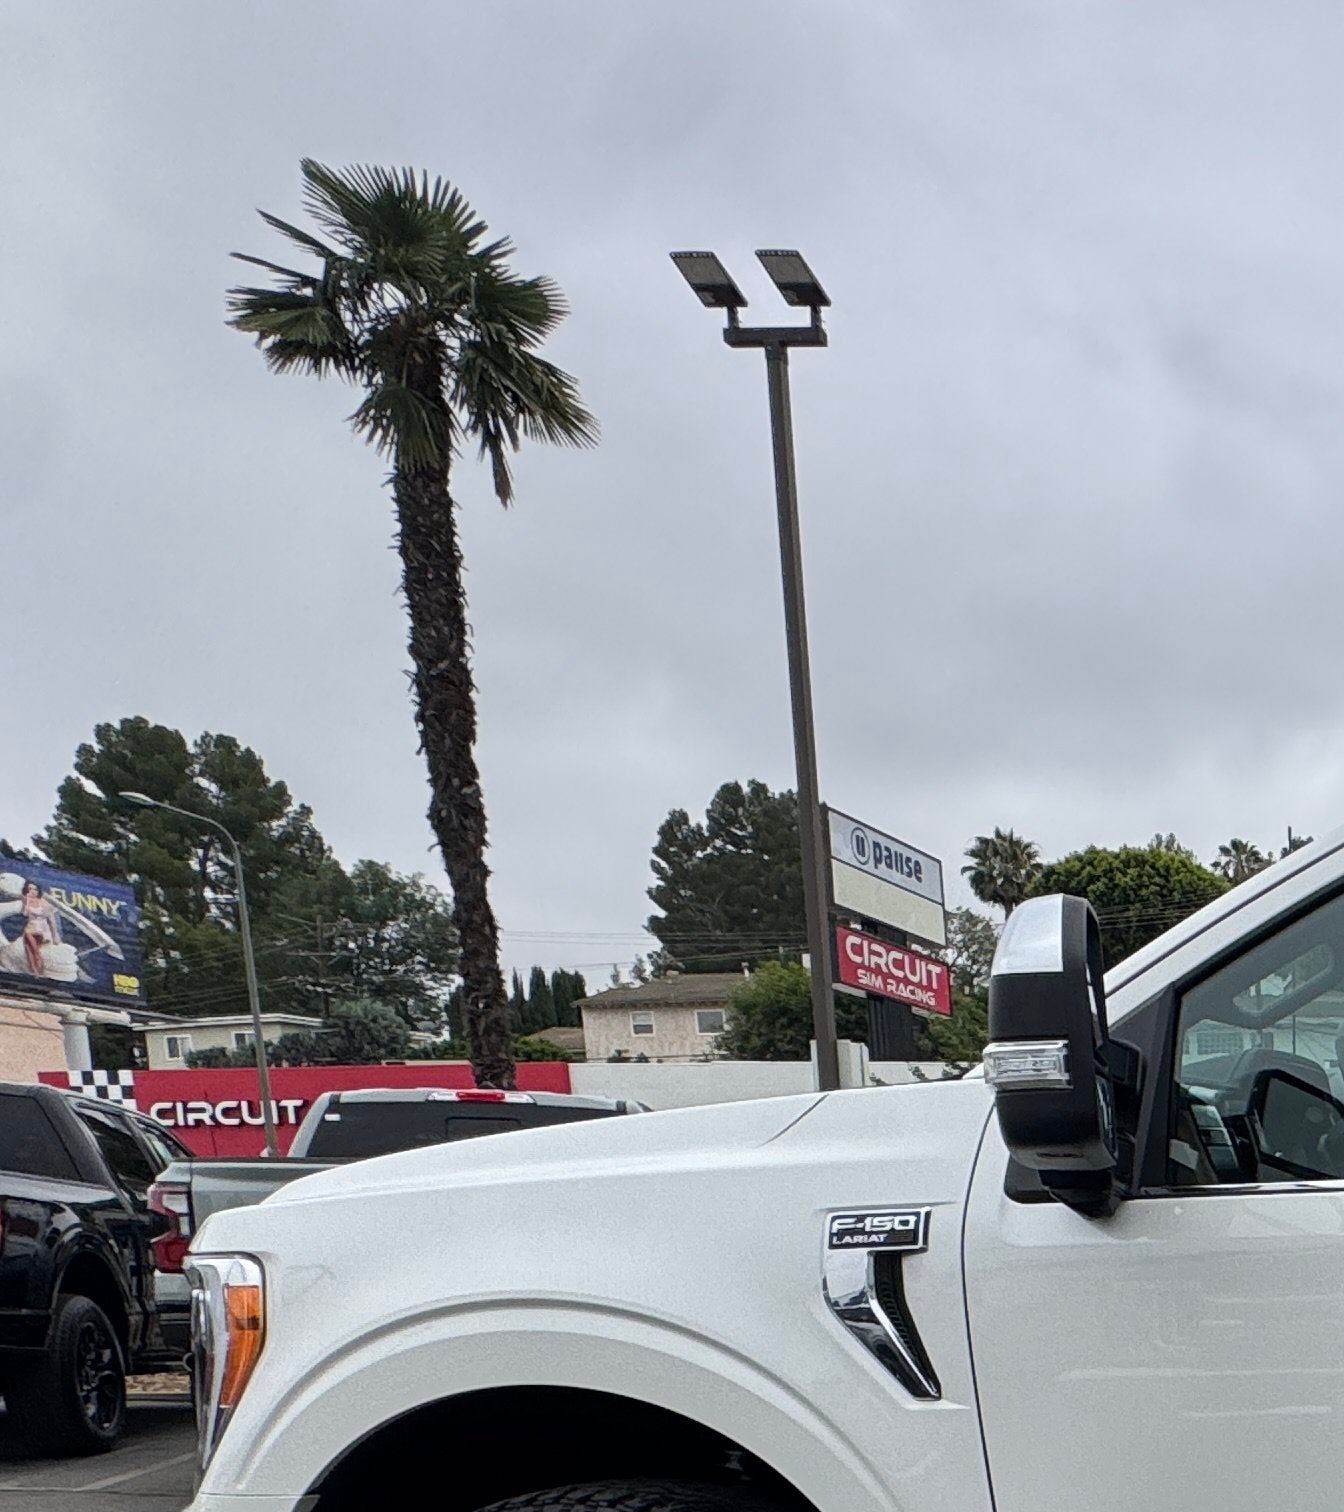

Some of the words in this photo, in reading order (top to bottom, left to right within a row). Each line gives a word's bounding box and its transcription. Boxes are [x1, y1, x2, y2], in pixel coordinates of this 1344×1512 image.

[845, 934, 943, 990] CIRCUIT
[856, 968, 884, 989] SIM
[886, 978, 936, 1006] RACING
[150, 1099, 304, 1127] CIRCUIT
[831, 1215, 918, 1233] F-150
[832, 1233, 889, 1245] LARIAT
